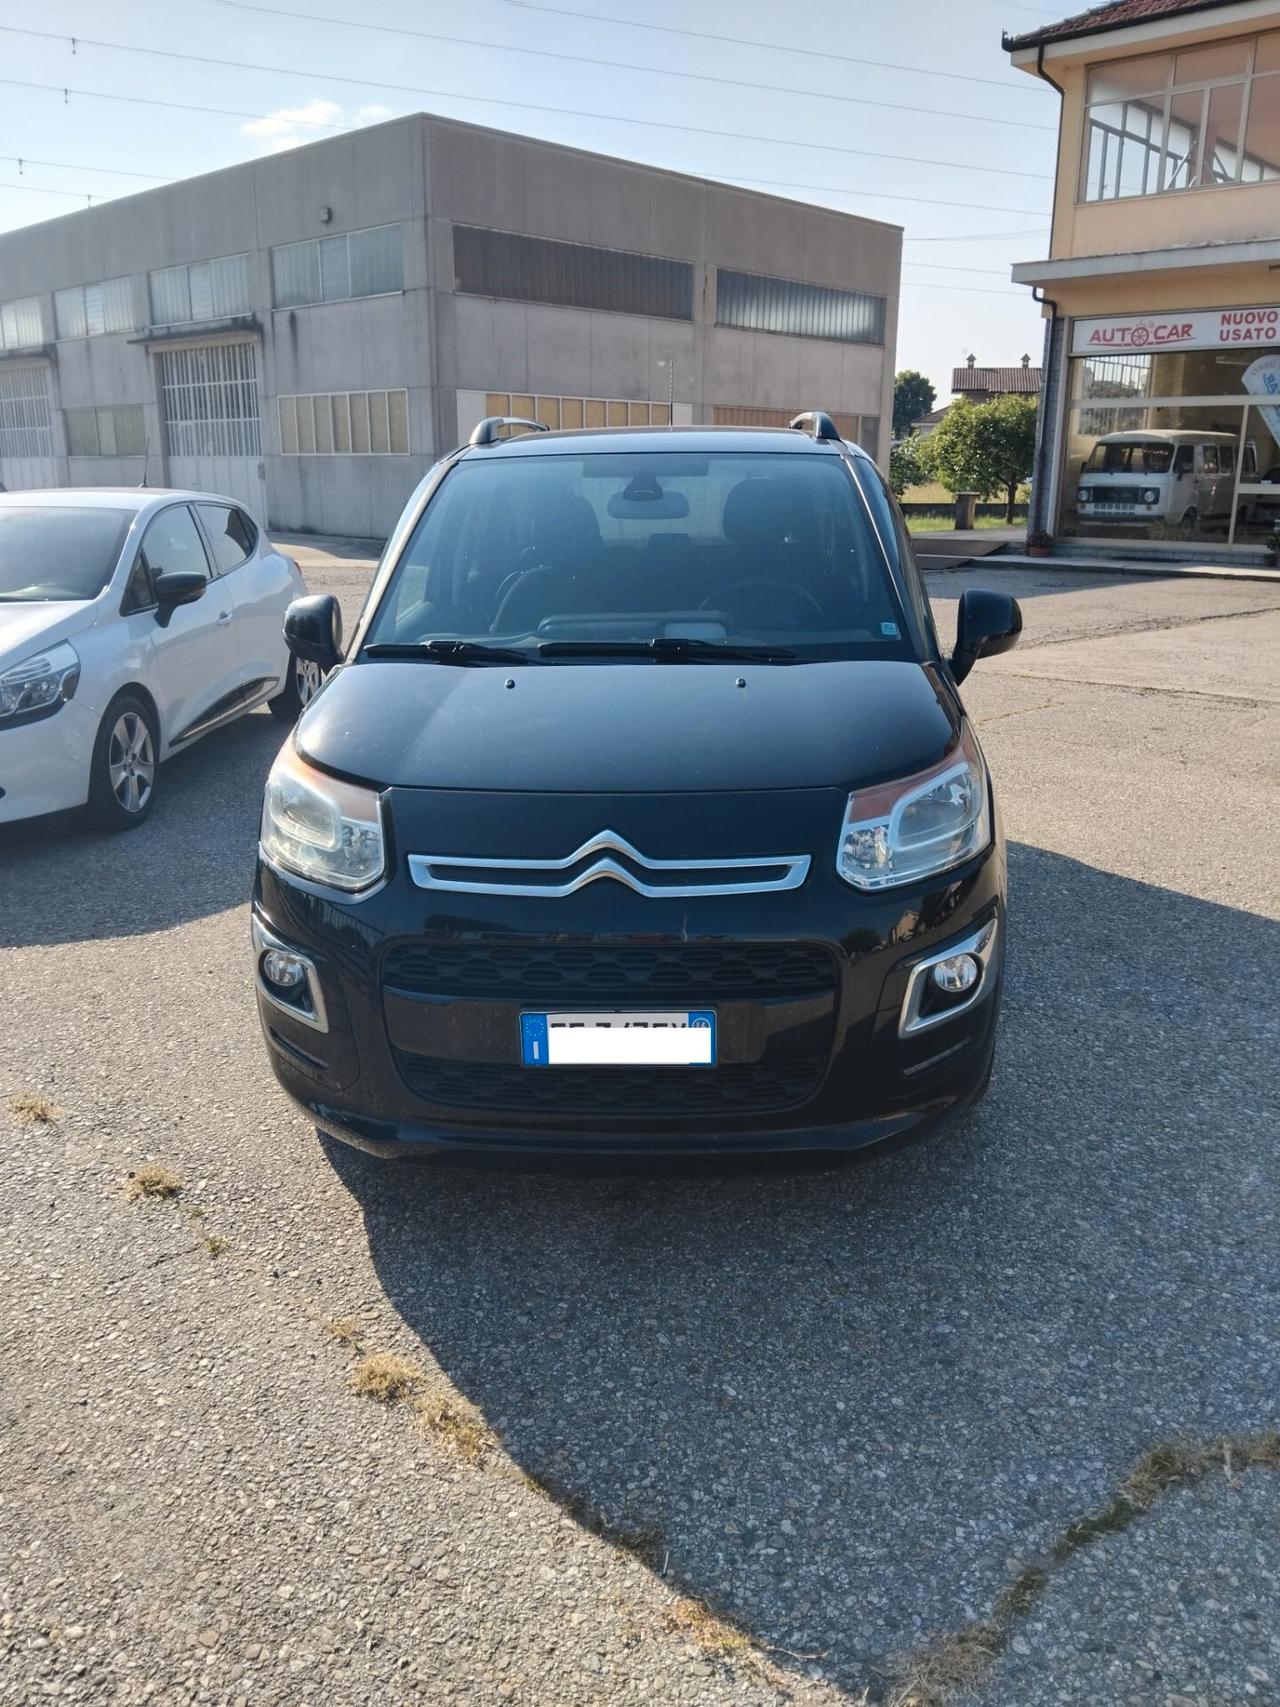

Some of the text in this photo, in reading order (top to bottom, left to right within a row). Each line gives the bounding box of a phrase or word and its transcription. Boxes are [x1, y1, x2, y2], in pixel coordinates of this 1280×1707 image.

[1220, 310, 1279, 326] NUOVO
[1219, 327, 1277, 342] USATO
[533, 1041, 539, 1060] I
